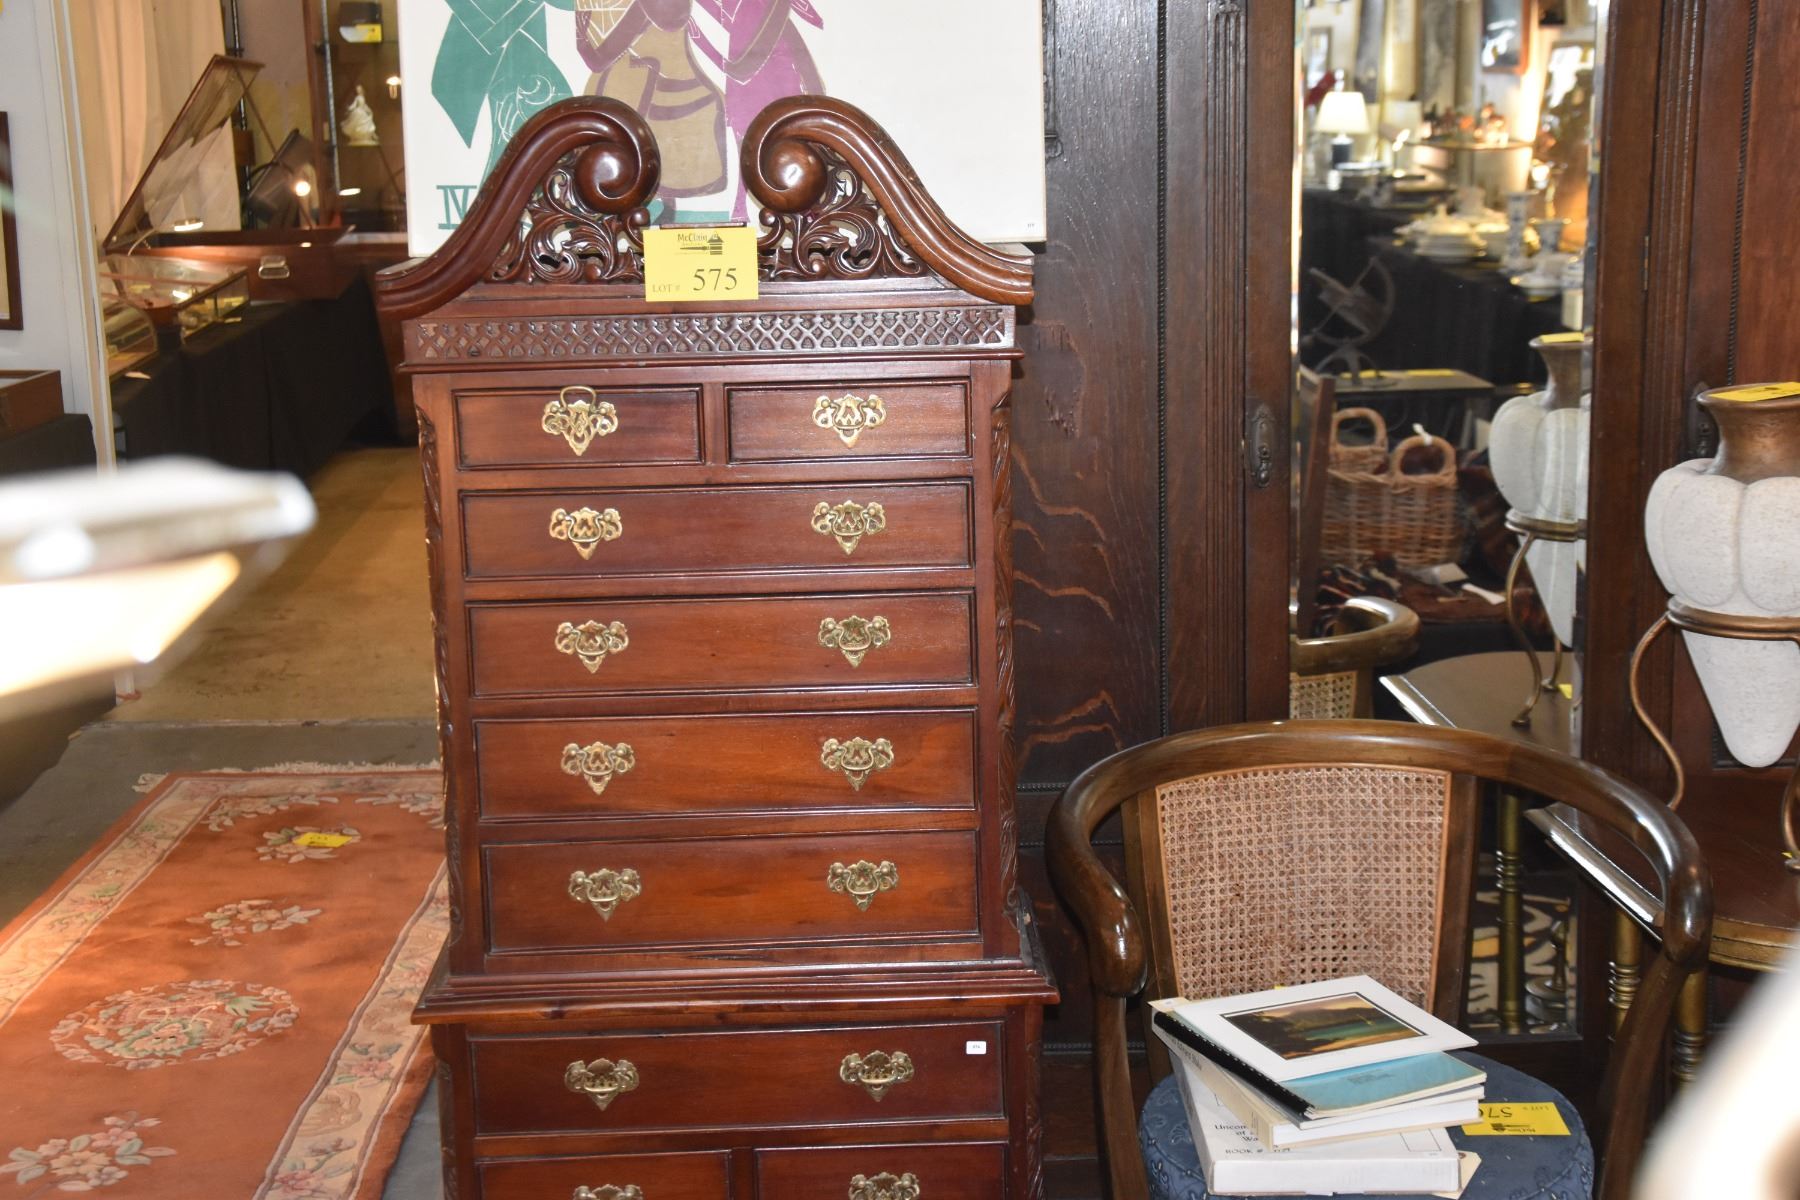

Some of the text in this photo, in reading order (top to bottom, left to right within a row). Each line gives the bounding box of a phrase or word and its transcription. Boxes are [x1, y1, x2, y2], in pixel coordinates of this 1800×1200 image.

[436, 184, 477, 230] IV
[677, 233, 708, 242] McClain
[652, 283, 672, 293] LOT
[692, 267, 738, 291] 575
